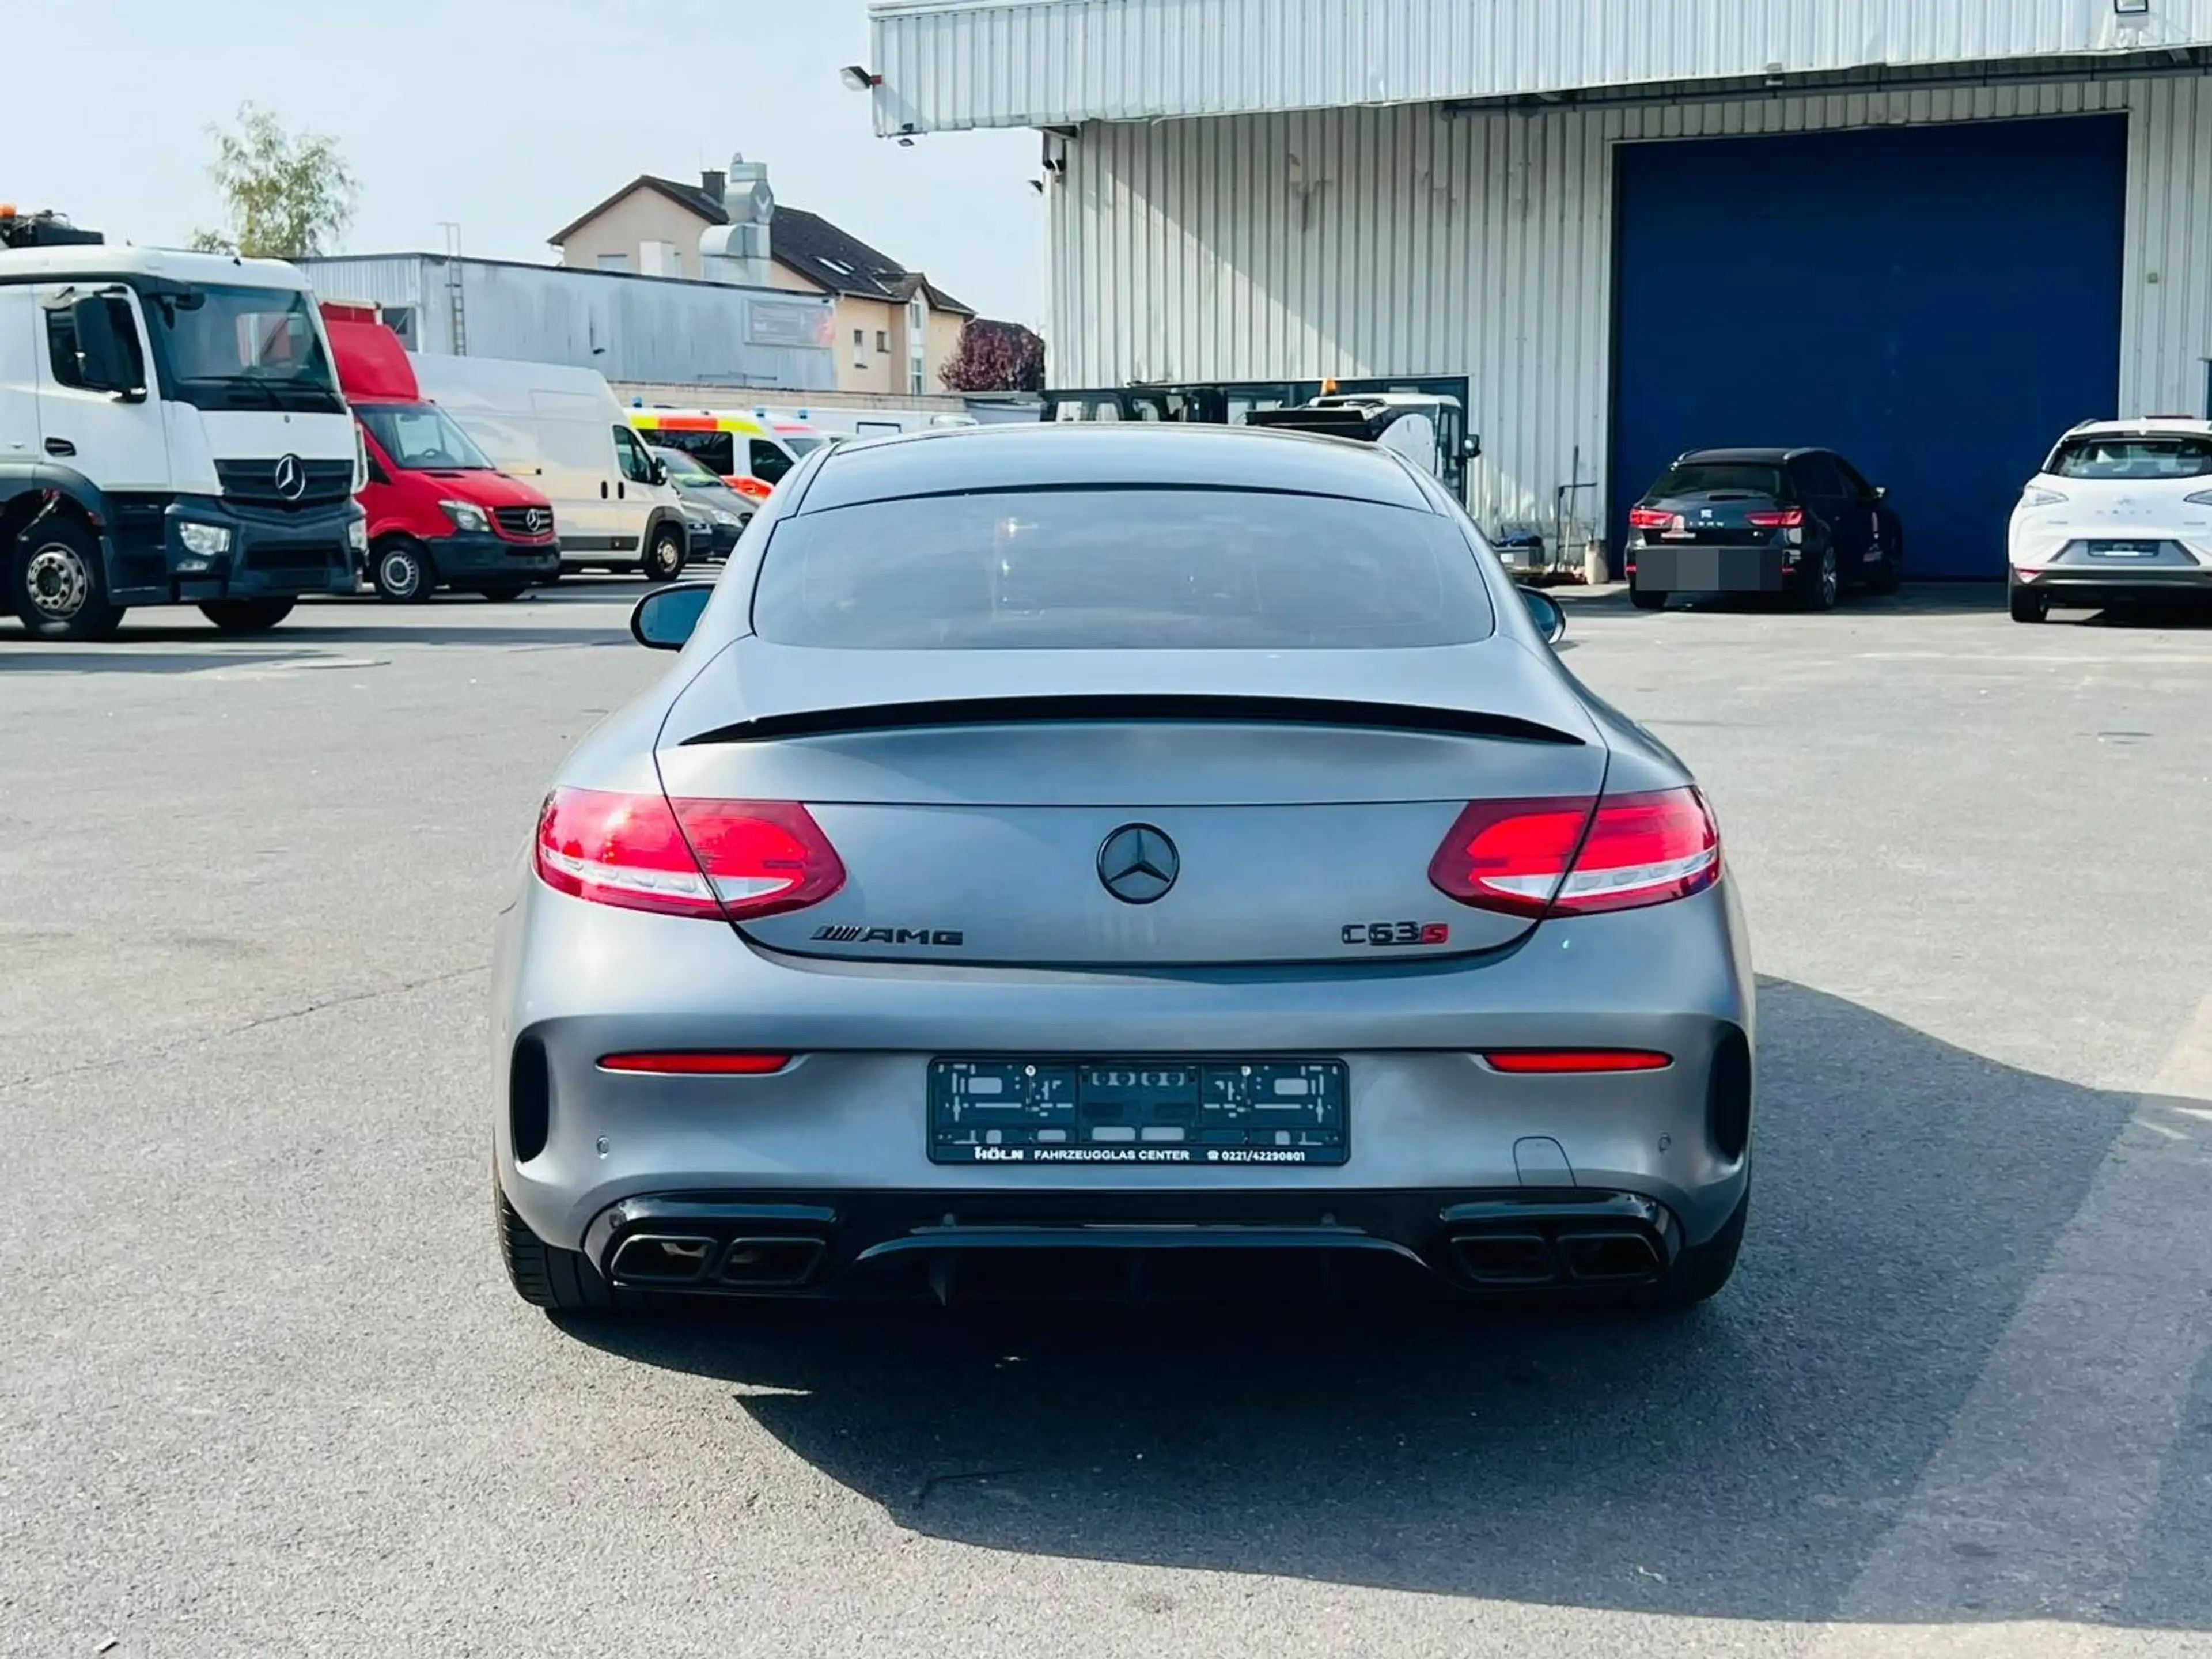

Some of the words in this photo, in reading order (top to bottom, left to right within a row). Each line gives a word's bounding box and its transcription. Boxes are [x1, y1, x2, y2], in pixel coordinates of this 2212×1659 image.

[858, 926, 964, 946] AMG
[1033, 1150, 1135, 1160] FAHRZEUGGLAS
[1138, 1150, 1190, 1160] CENTER
